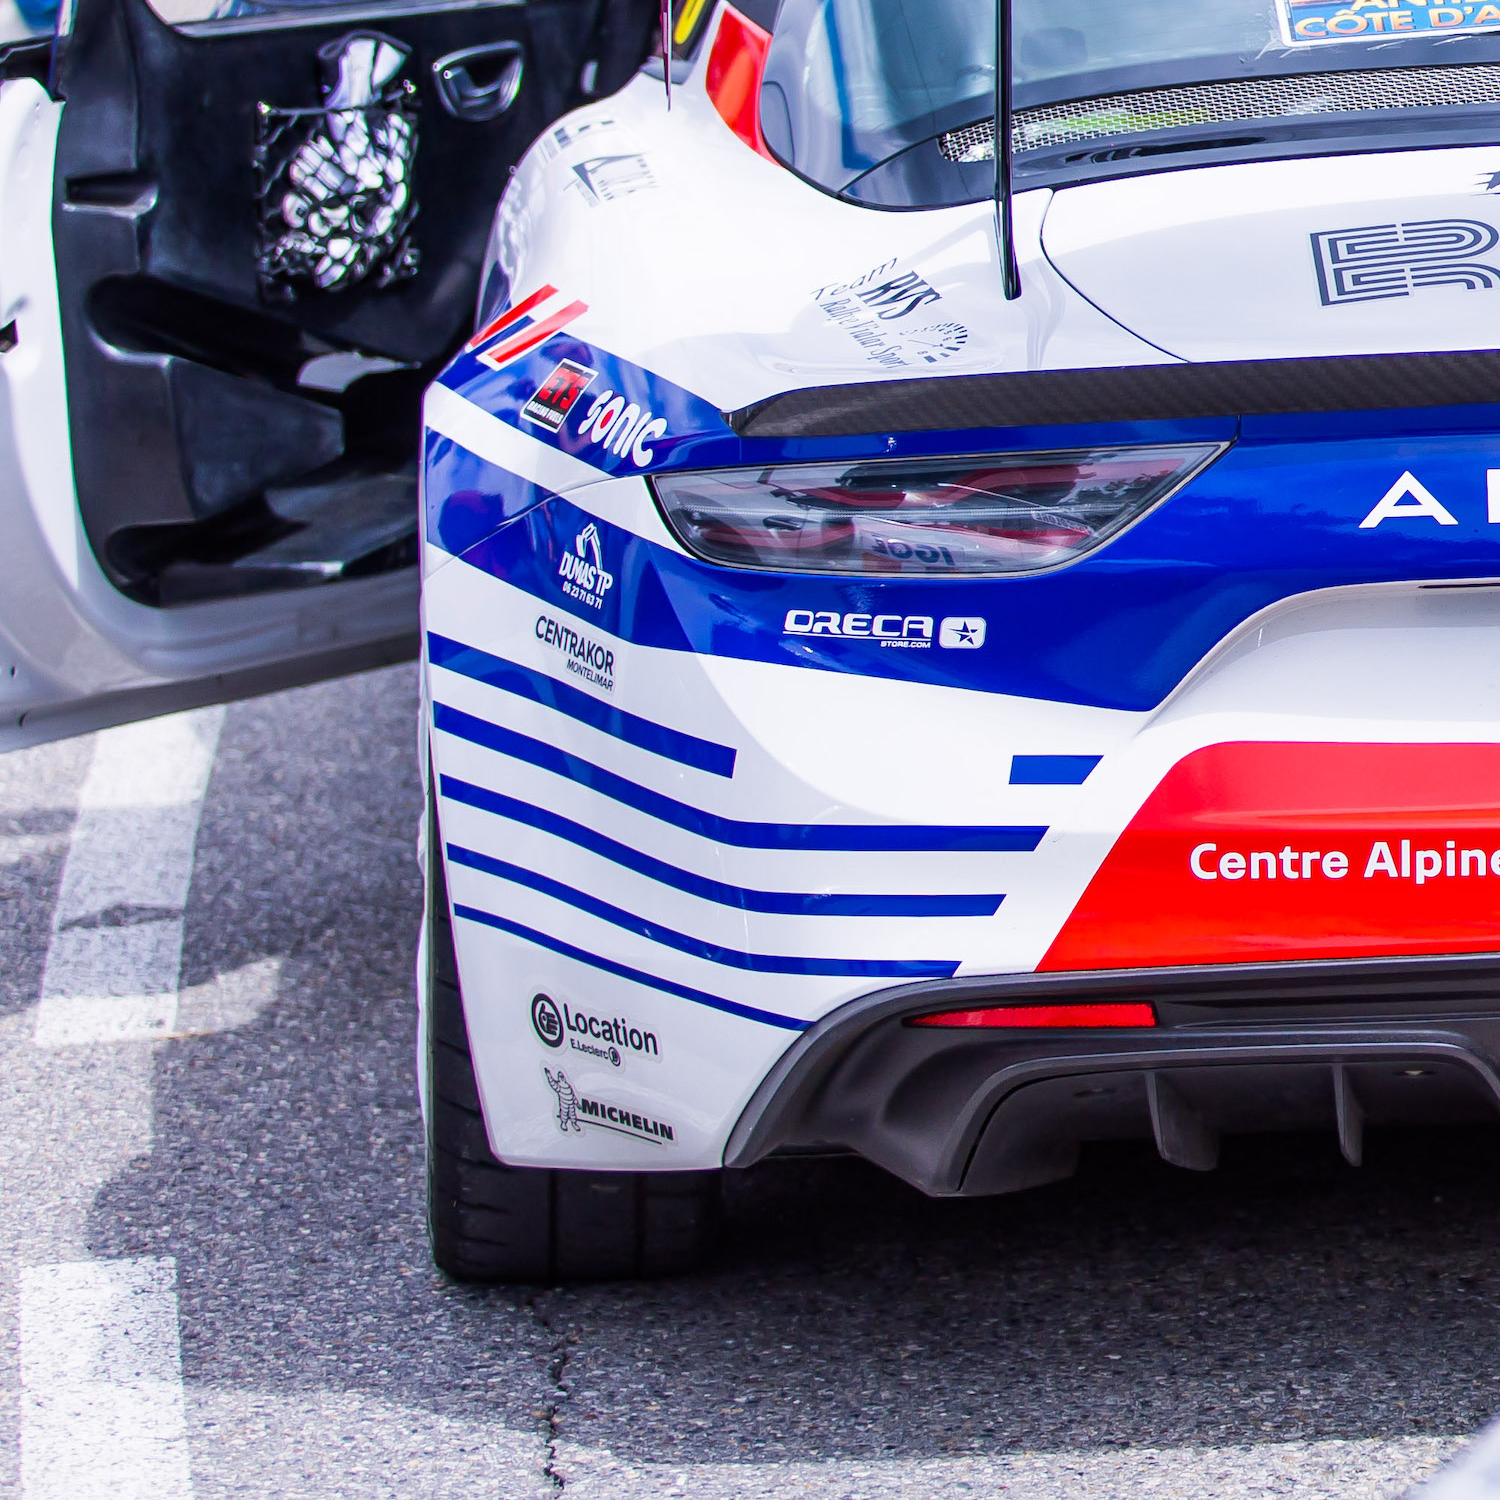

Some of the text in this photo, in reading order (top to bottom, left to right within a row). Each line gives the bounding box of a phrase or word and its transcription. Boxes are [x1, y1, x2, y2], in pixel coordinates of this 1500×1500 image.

[1295, 9, 1415, 37] CÔTE
[809, 257, 897, 300] Team
[855, 270, 943, 320] RVS
[819, 298, 861, 325] Rallye
[867, 345, 911, 368] Sport
[559, 551, 613, 597] DUMAS TP
[562, 581, 572, 594] 06
[783, 609, 934, 637] ORECA
[880, 639, 931, 649] STORE.COM
[535, 615, 614, 676] CENTRAKOR
[567, 658, 614, 692] MONTELIMAR
[1189, 841, 1348, 881] Centre
[564, 1003, 658, 1055] Location
[581, 1098, 674, 1141] MICHELIN
